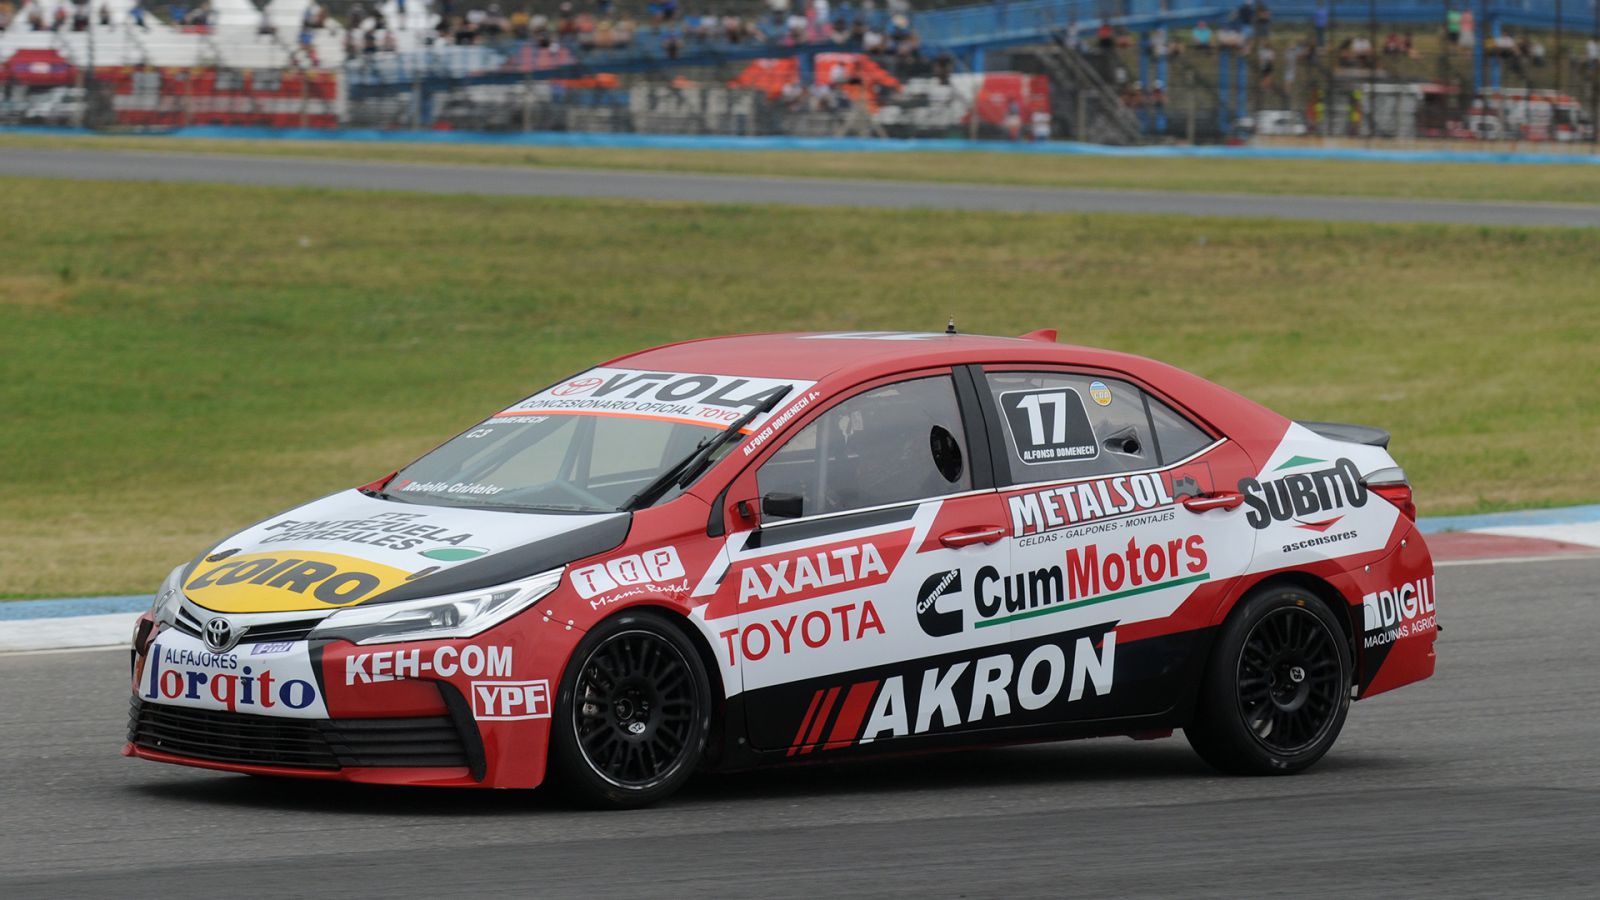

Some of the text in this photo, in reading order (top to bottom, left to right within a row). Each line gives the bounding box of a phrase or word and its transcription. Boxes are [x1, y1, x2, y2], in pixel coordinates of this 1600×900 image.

[520, 399, 757, 425] CONCESIONARIO OFICIAL TOYO
[743, 390, 821, 456] ALFONSO DOMENECH A+
[1016, 392, 1066, 446] 17
[1023, 445, 1095, 460] ALFONSO DOMENECH
[1008, 473, 1174, 539] METALSOL
[259, 530, 424, 551] CEREALES
[264, 520, 473, 546] FONTEZUELA
[1019, 534, 1058, 548] CELDAS
[1066, 522, 1117, 539] GALPONES
[1125, 512, 1175, 528] MONTAJES
[1282, 530, 1358, 553] ascensores
[186, 558, 381, 605] COIRO
[579, 550, 671, 593] TOP
[738, 543, 888, 605] AXALTA
[917, 568, 958, 615] Cummins
[973, 534, 1208, 618] CumMotors
[590, 578, 690, 611] Miami Rental
[720, 600, 886, 667] TOYOTA
[1364, 625, 1409, 649] MAQUINAS
[164, 648, 238, 670] ALFAJORES
[346, 645, 513, 686] KEH-COM
[476, 685, 545, 716] YPF
[859, 630, 1118, 744] AKRON
